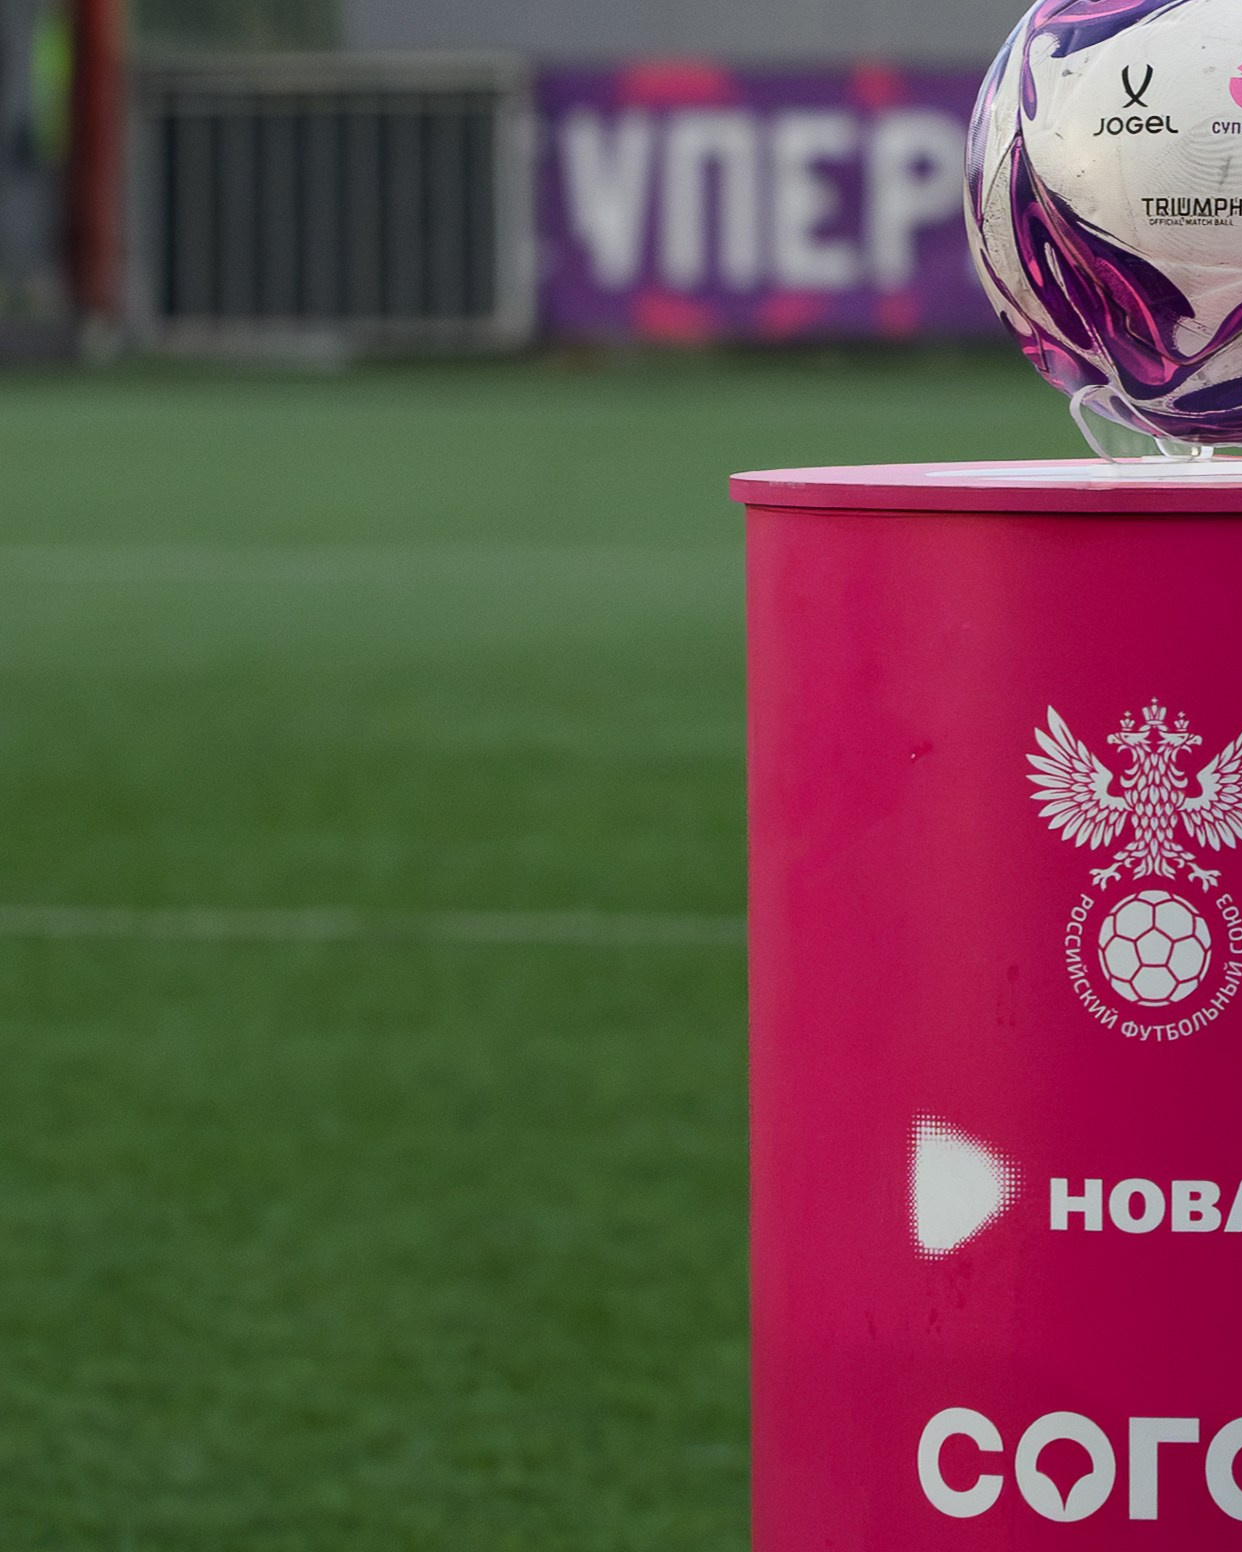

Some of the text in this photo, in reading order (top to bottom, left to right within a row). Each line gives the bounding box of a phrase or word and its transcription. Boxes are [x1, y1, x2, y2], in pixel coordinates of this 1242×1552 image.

[560, 104, 972, 294] УПЕР
[1141, 197, 1242, 217] TRIUMPH
[1149, 218, 1234, 226] OFFICIAL MATCH BALL
[1064, 893, 1119, 1030] РОССИЙСКИЙ
